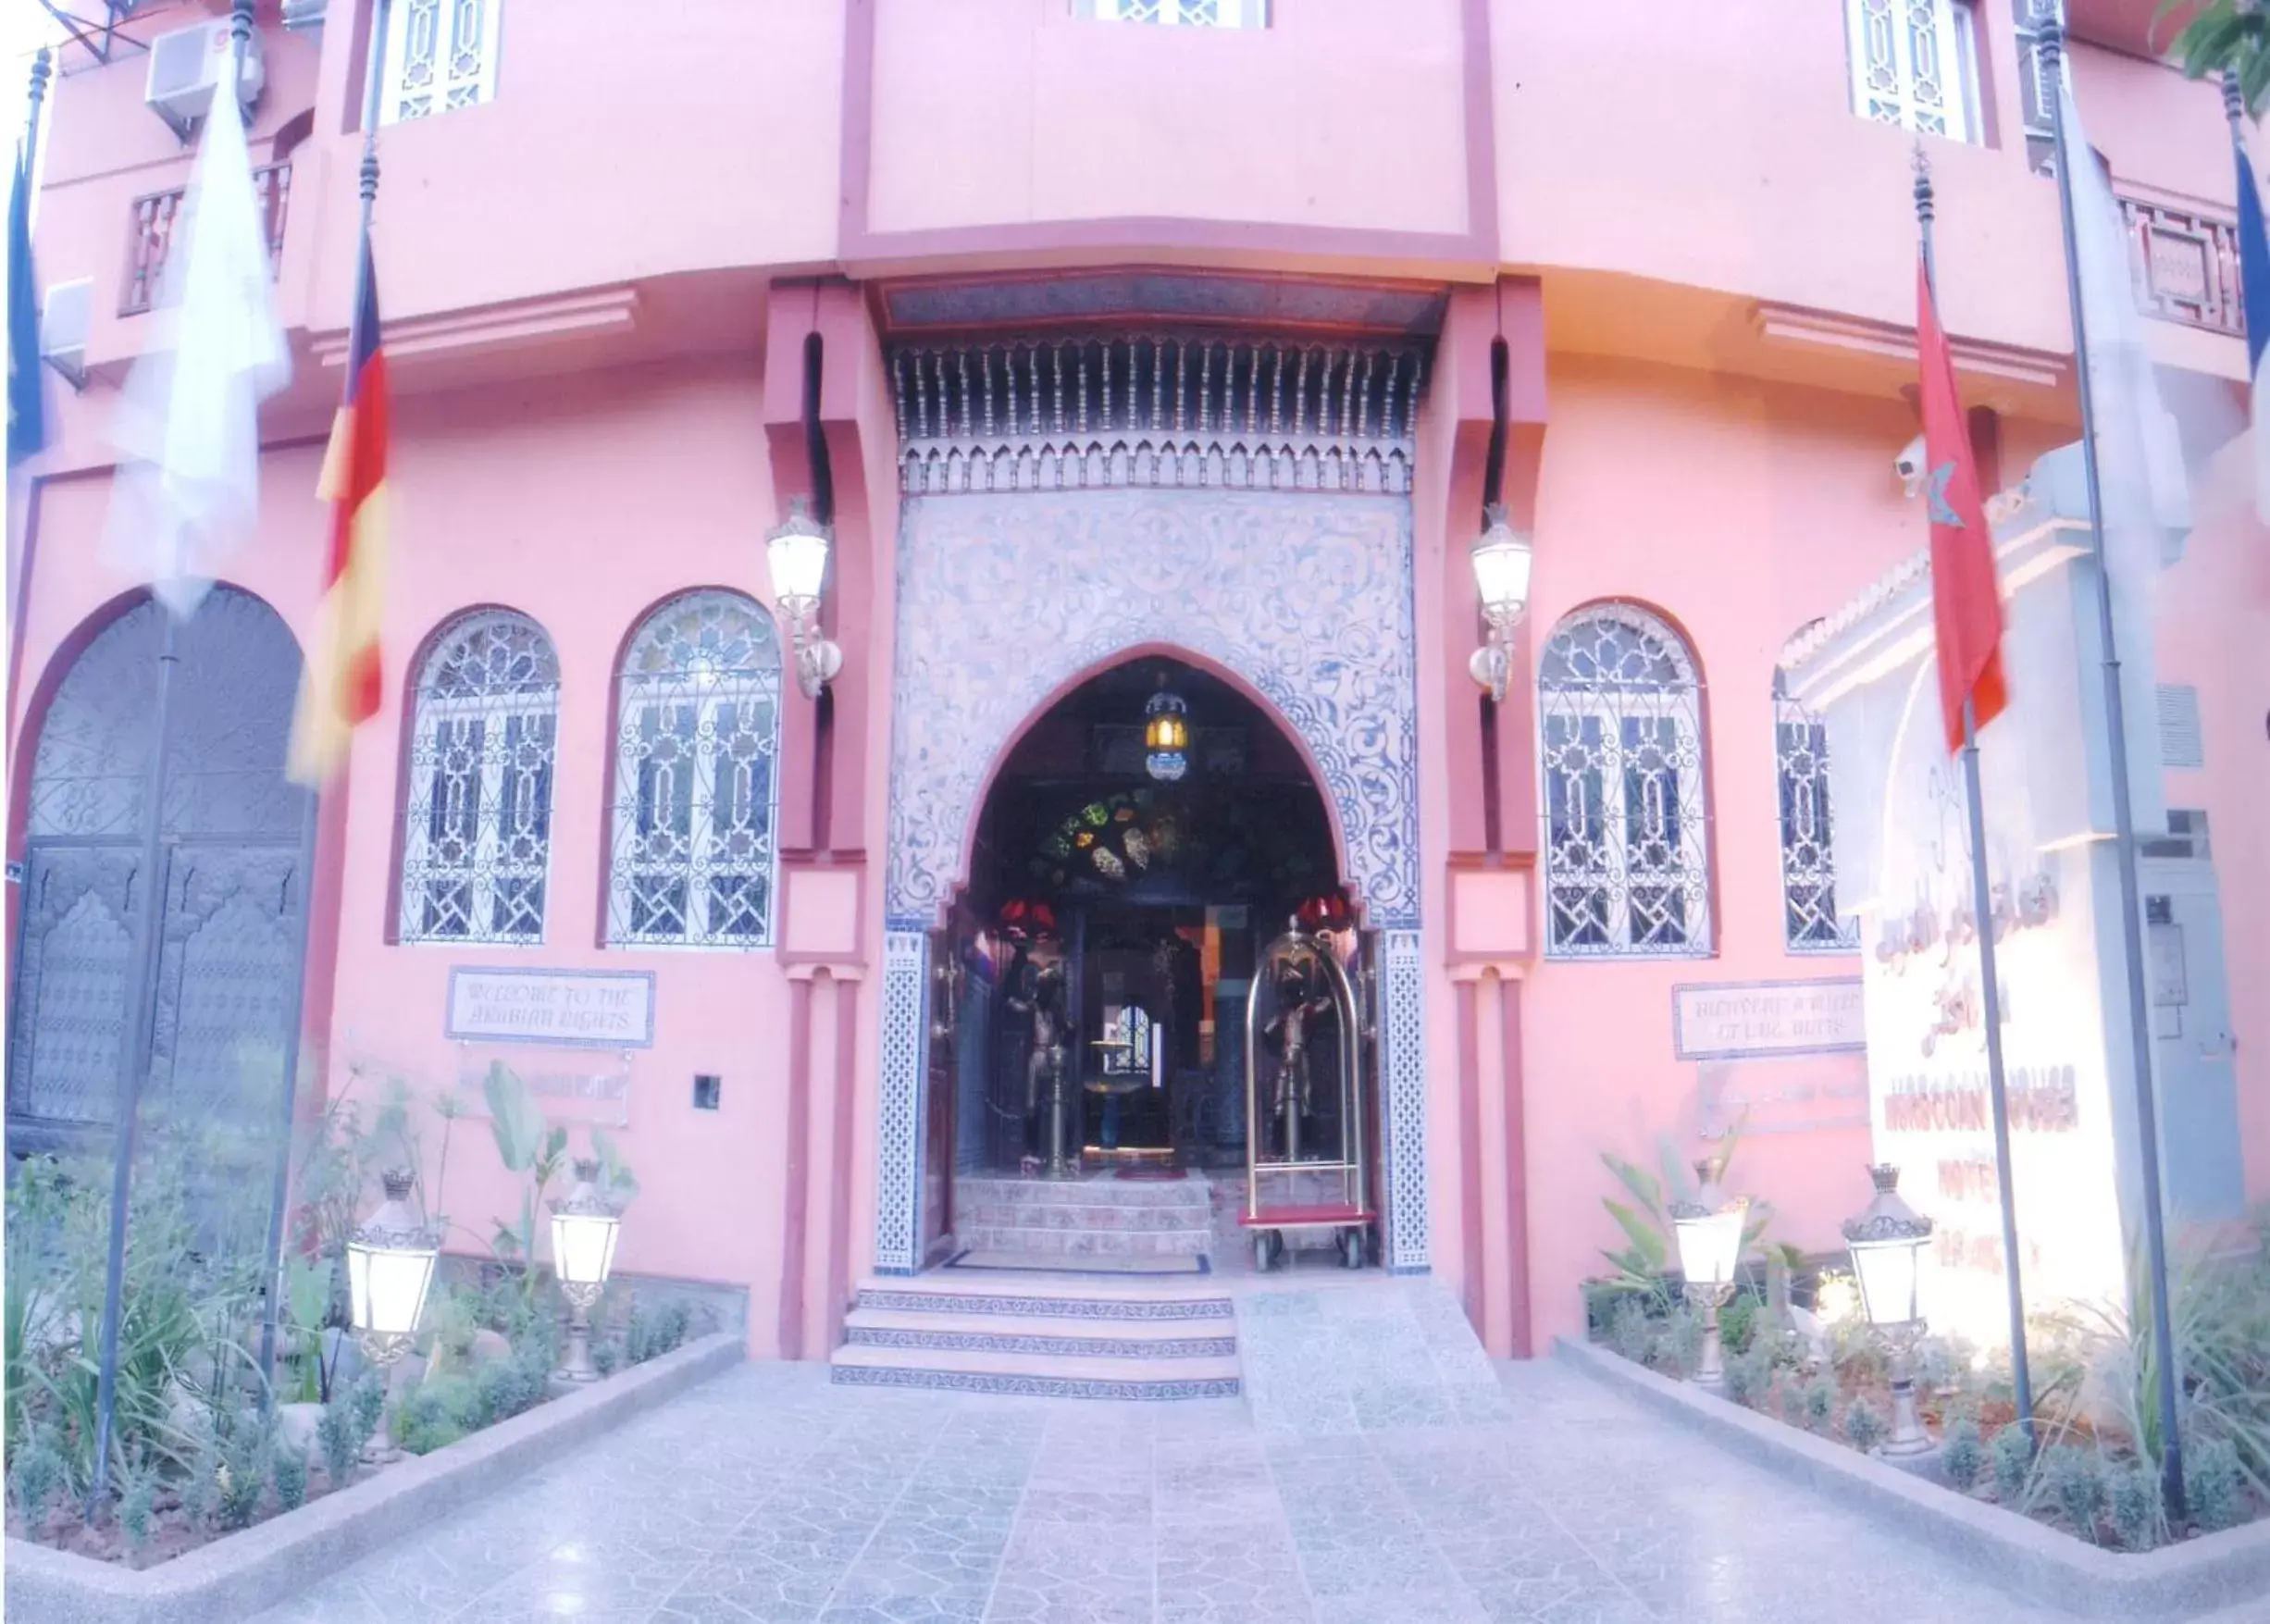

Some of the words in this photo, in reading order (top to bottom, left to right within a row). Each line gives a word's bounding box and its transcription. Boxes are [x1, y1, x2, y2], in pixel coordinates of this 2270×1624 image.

[564, 986, 590, 1006] TO
[598, 987, 633, 1008] THE
[1937, 1158, 2002, 1204] HOTE
